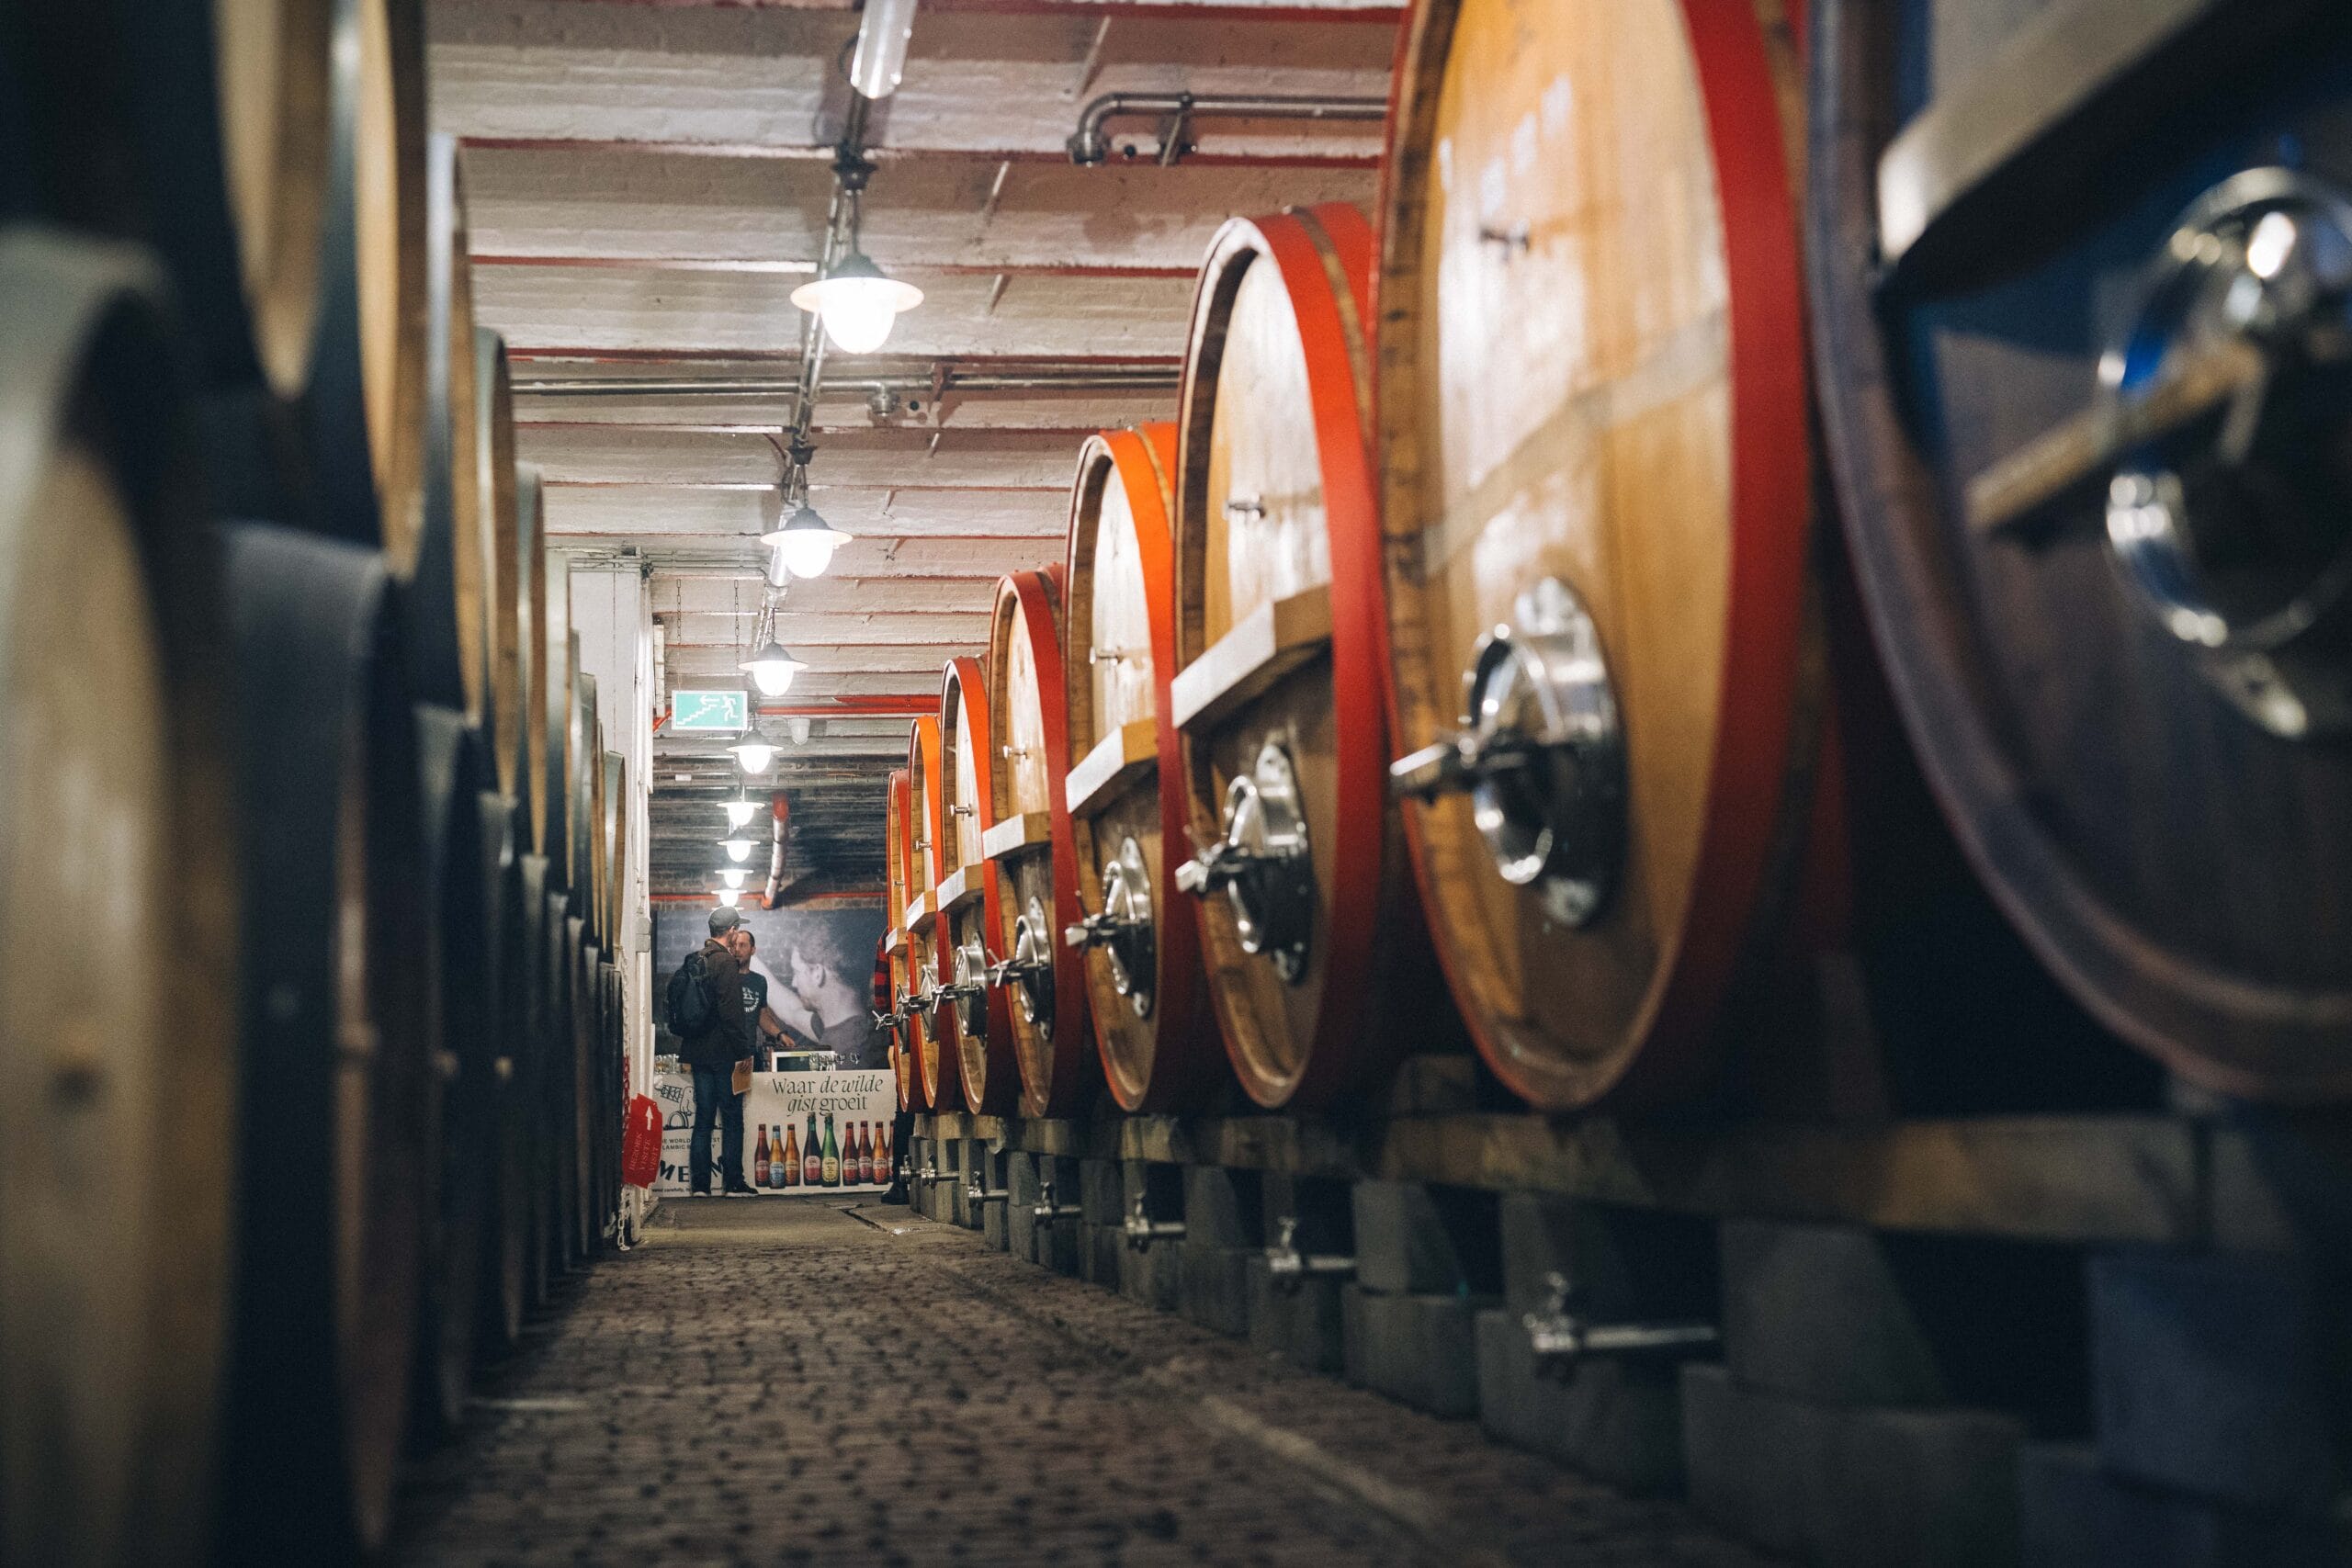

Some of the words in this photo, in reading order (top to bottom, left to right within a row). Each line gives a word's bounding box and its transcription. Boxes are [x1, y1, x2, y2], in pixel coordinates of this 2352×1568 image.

[773, 1078, 816, 1095] Waar
[820, 1076, 839, 1093] de
[842, 1075, 884, 1093] wilde
[786, 1094, 817, 1117] gist
[820, 1093, 868, 1116] groeit
[649, 1145, 659, 1170] VISIT
